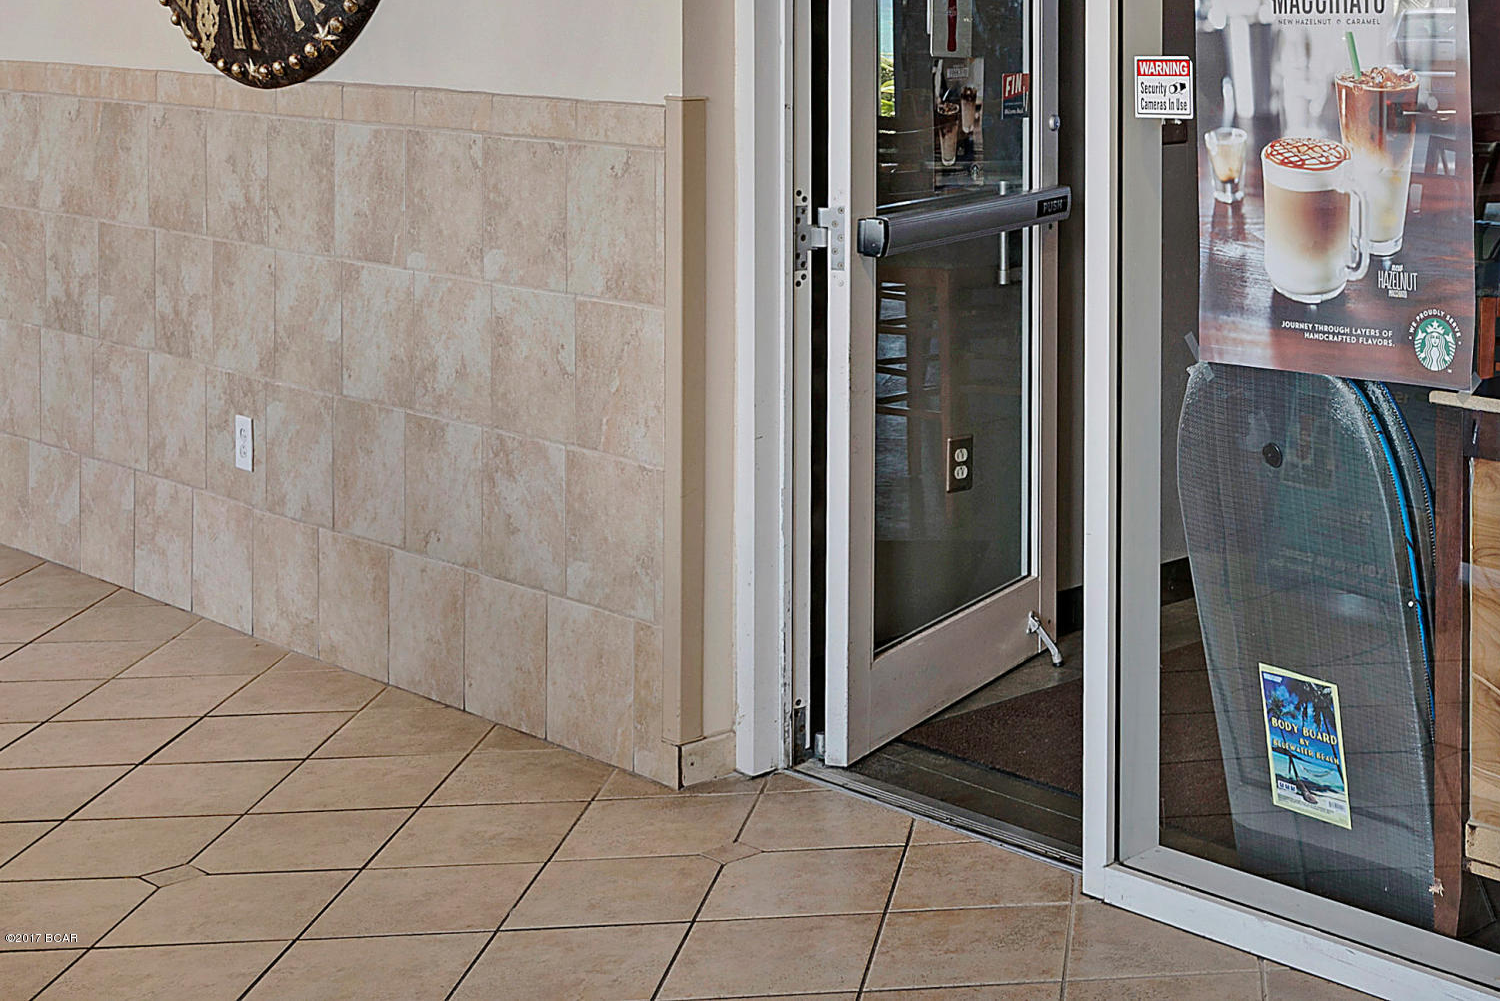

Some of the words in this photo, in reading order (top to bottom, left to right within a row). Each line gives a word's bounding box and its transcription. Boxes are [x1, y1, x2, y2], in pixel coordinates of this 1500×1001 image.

[1346, 18, 1381, 26] CARAMEL
[1138, 61, 1189, 76] WARNING
[1140, 81, 1168, 97] Security
[1140, 97, 1167, 111] Cameras
[1168, 98, 1175, 111] In
[1175, 98, 1188, 111] Use
[1377, 270, 1418, 292] HAZELNUT
[1281, 320, 1314, 331] JOURNEY
[1313, 323, 1350, 335] THROUGH
[1351, 327, 1380, 337] LAYERS
[1381, 330, 1393, 338] OF
[1303, 331, 1357, 344] HANDCRAFTED
[1358, 336, 1397, 348] FLAVORS.
[1270, 716, 1299, 734] BODY
[1302, 726, 1338, 745] BOARD
[1299, 737, 1310, 747] BY
